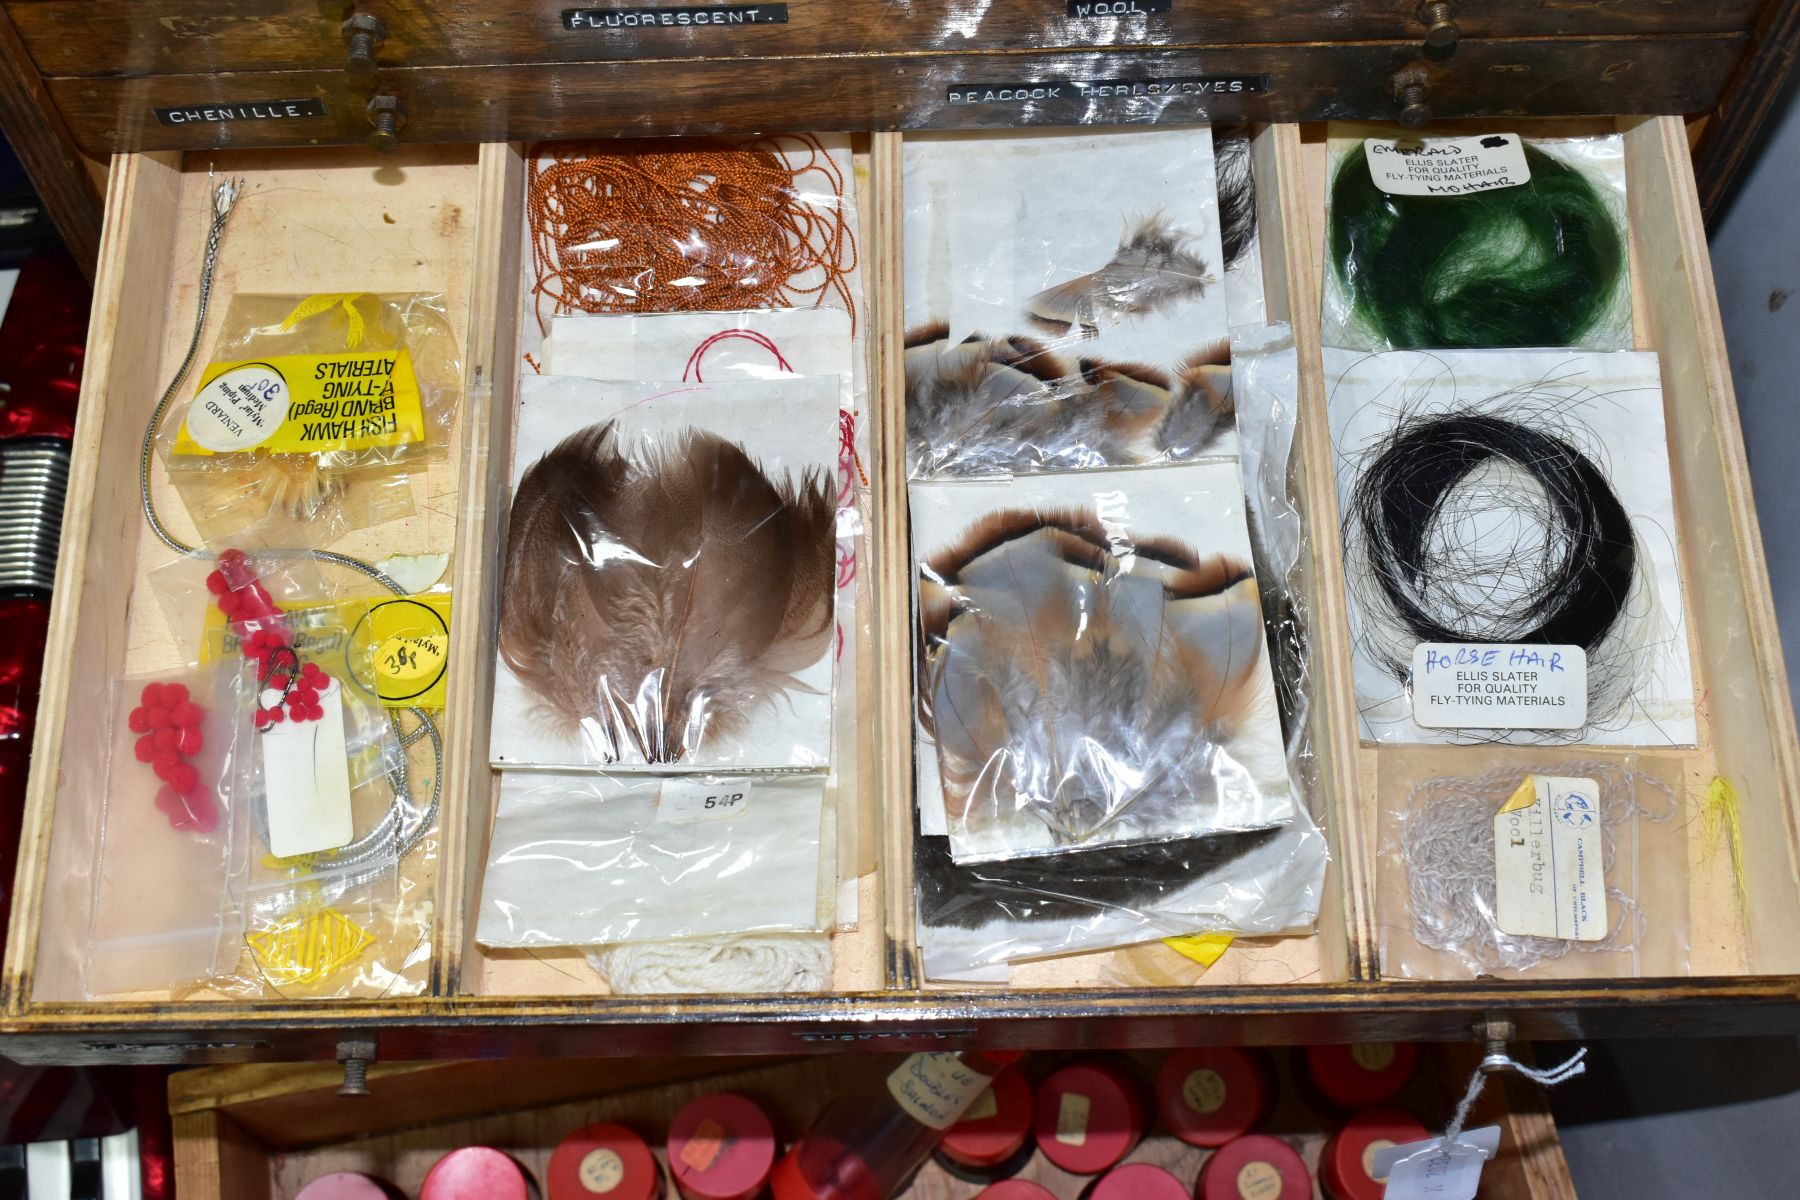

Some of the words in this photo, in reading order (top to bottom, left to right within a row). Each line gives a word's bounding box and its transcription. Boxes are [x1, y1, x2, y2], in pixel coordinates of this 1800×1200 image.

[1076, 1, 1156, 17] WOOL.
[570, 10, 774, 28] FLUORESCENT.
[950, 87, 1060, 103] PEACOCK
[168, 105, 313, 123] CHENILLE.
[1405, 158, 1433, 166] ELLIS
[1436, 155, 1479, 166] SLATER
[1408, 166, 1429, 174] FOR
[1432, 163, 1480, 174] QUALITY
[1386, 172, 1441, 182] FLY-TYING
[1444, 166, 1508, 181] MATERIALS
[1427, 177, 1515, 193] MOHAIR
[314, 359, 395, 380] ATERIALS
[219, 381, 241, 405] Piping
[238, 384, 267, 412] Medium
[322, 379, 394, 399] FY-TYING
[205, 401, 243, 437] VENIARD
[288, 399, 339, 421] (Regd)
[300, 419, 355, 441] HAWK
[1425, 647, 1500, 674] HORSE
[1509, 648, 1565, 673] HAIR
[1456, 671, 1488, 681] ELLIS
[1492, 671, 1538, 681] SLATER
[1458, 683, 1481, 693] FOR
[1485, 683, 1538, 694] QUALITY
[1430, 695, 1492, 706] FLY-TYING
[1496, 695, 1565, 706] MATERIALS
[1580, 892, 1588, 922] BLACK
